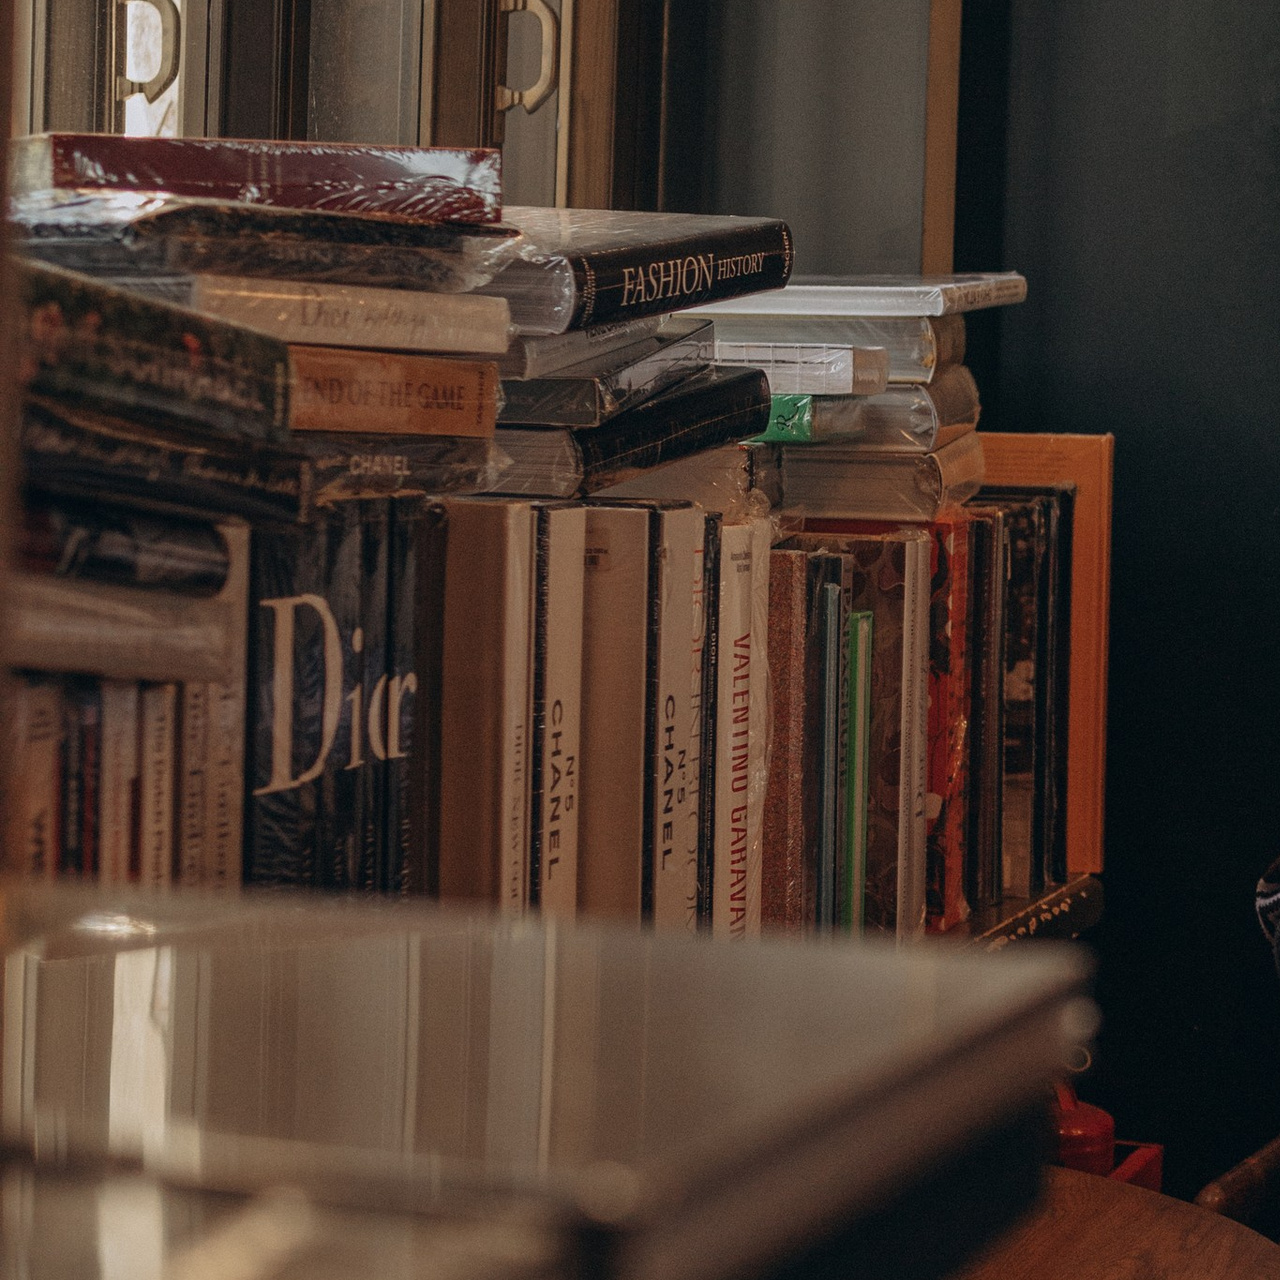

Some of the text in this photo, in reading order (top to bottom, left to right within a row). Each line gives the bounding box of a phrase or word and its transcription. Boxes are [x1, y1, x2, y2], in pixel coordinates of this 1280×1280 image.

[620, 253, 714, 307] FASHION
[717, 251, 765, 280] HISTORY
[781, 230, 789, 279] TASCHEN
[303, 375, 343, 405] END
[347, 380, 370, 407] OF
[378, 381, 413, 408] THE
[417, 383, 466, 412] GAME
[349, 454, 411, 477] CHANEL
[253, 593, 416, 797] Dior
[731, 632, 751, 792] VALENTINO
[840, 586, 852, 789] PARACHUTE
[547, 699, 563, 881] CHANEL
[661, 694, 675, 871] CHANEL
